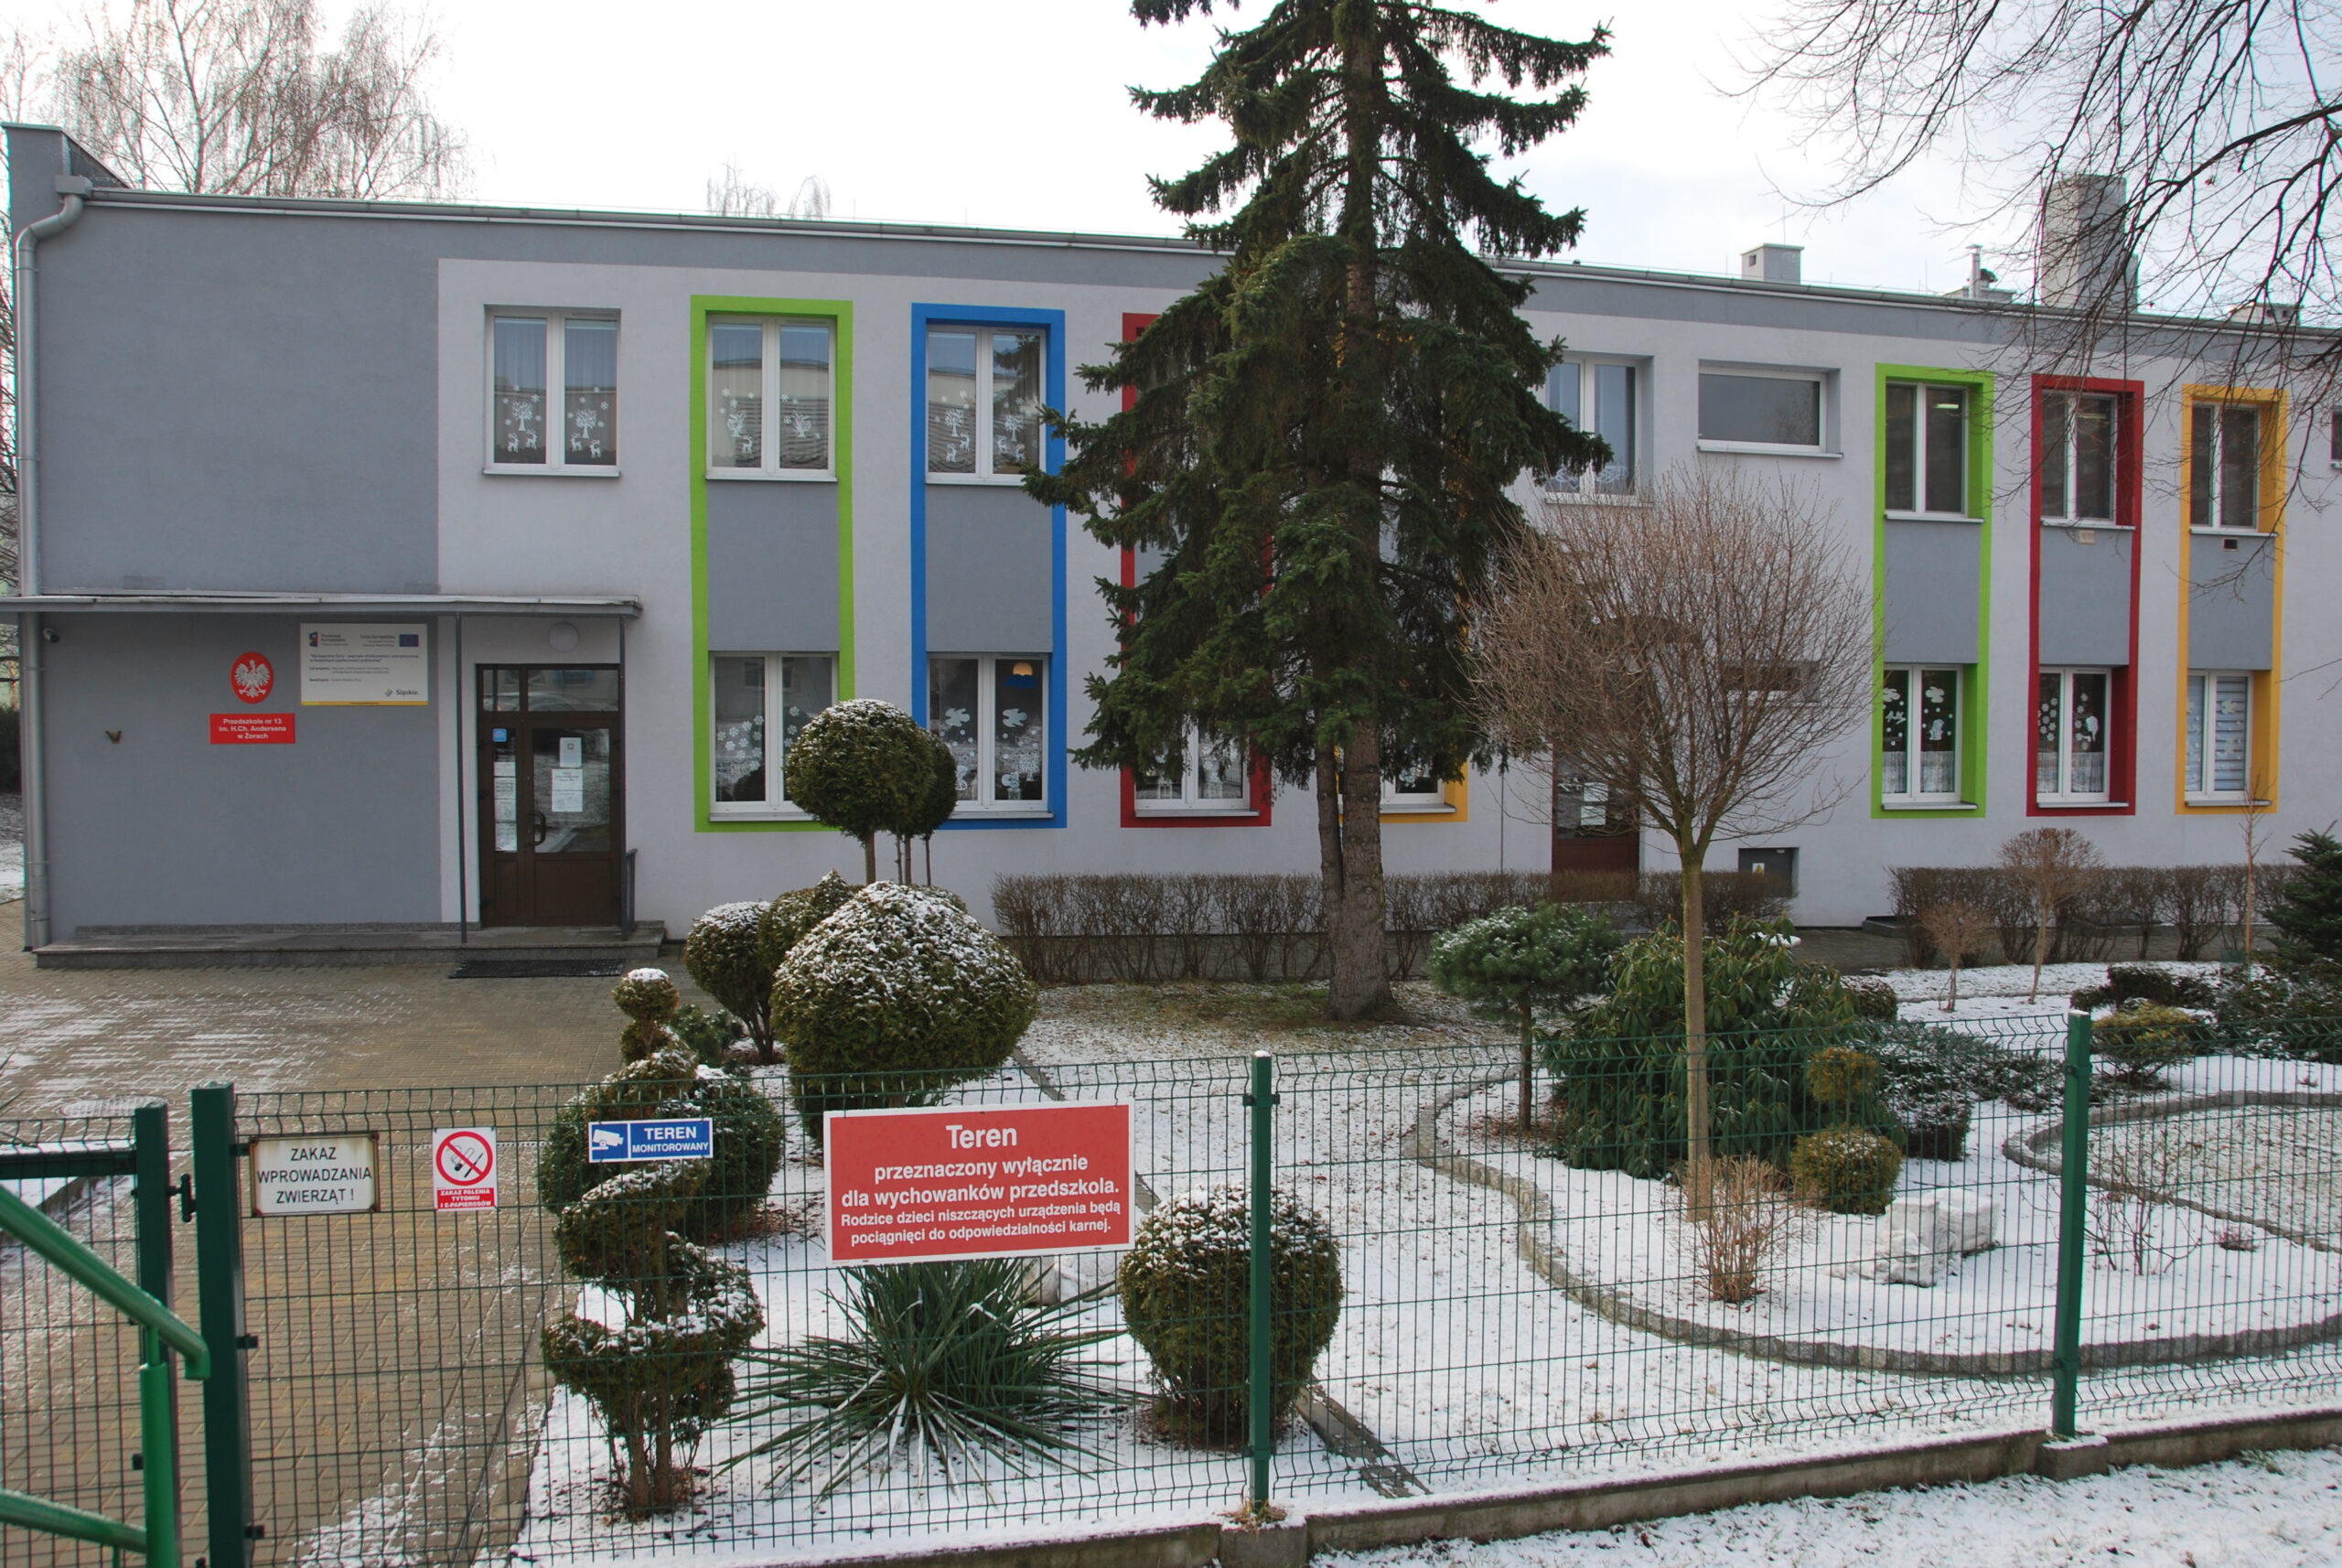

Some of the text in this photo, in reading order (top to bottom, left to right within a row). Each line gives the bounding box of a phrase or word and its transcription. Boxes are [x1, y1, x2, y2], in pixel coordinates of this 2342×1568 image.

[644, 1126, 697, 1141] TEREN
[946, 1123, 1017, 1149] Teren
[291, 1147, 337, 1161] ZAKAZ
[632, 1142, 709, 1154] MONITOROWANY
[257, 1167, 372, 1183] WPROWADZANIA
[875, 1154, 1089, 1185] przeznaczony wyłącznie
[276, 1188, 354, 1205] ZWIERZĄT !
[841, 1177, 1120, 1209] dla wychowanków przedszkola.
[841, 1200, 1121, 1227] Rodzice dzieci niszczących urządzenia będą
[851, 1218, 1112, 1247] pociągnięci do odpowiedzialności karnej.
